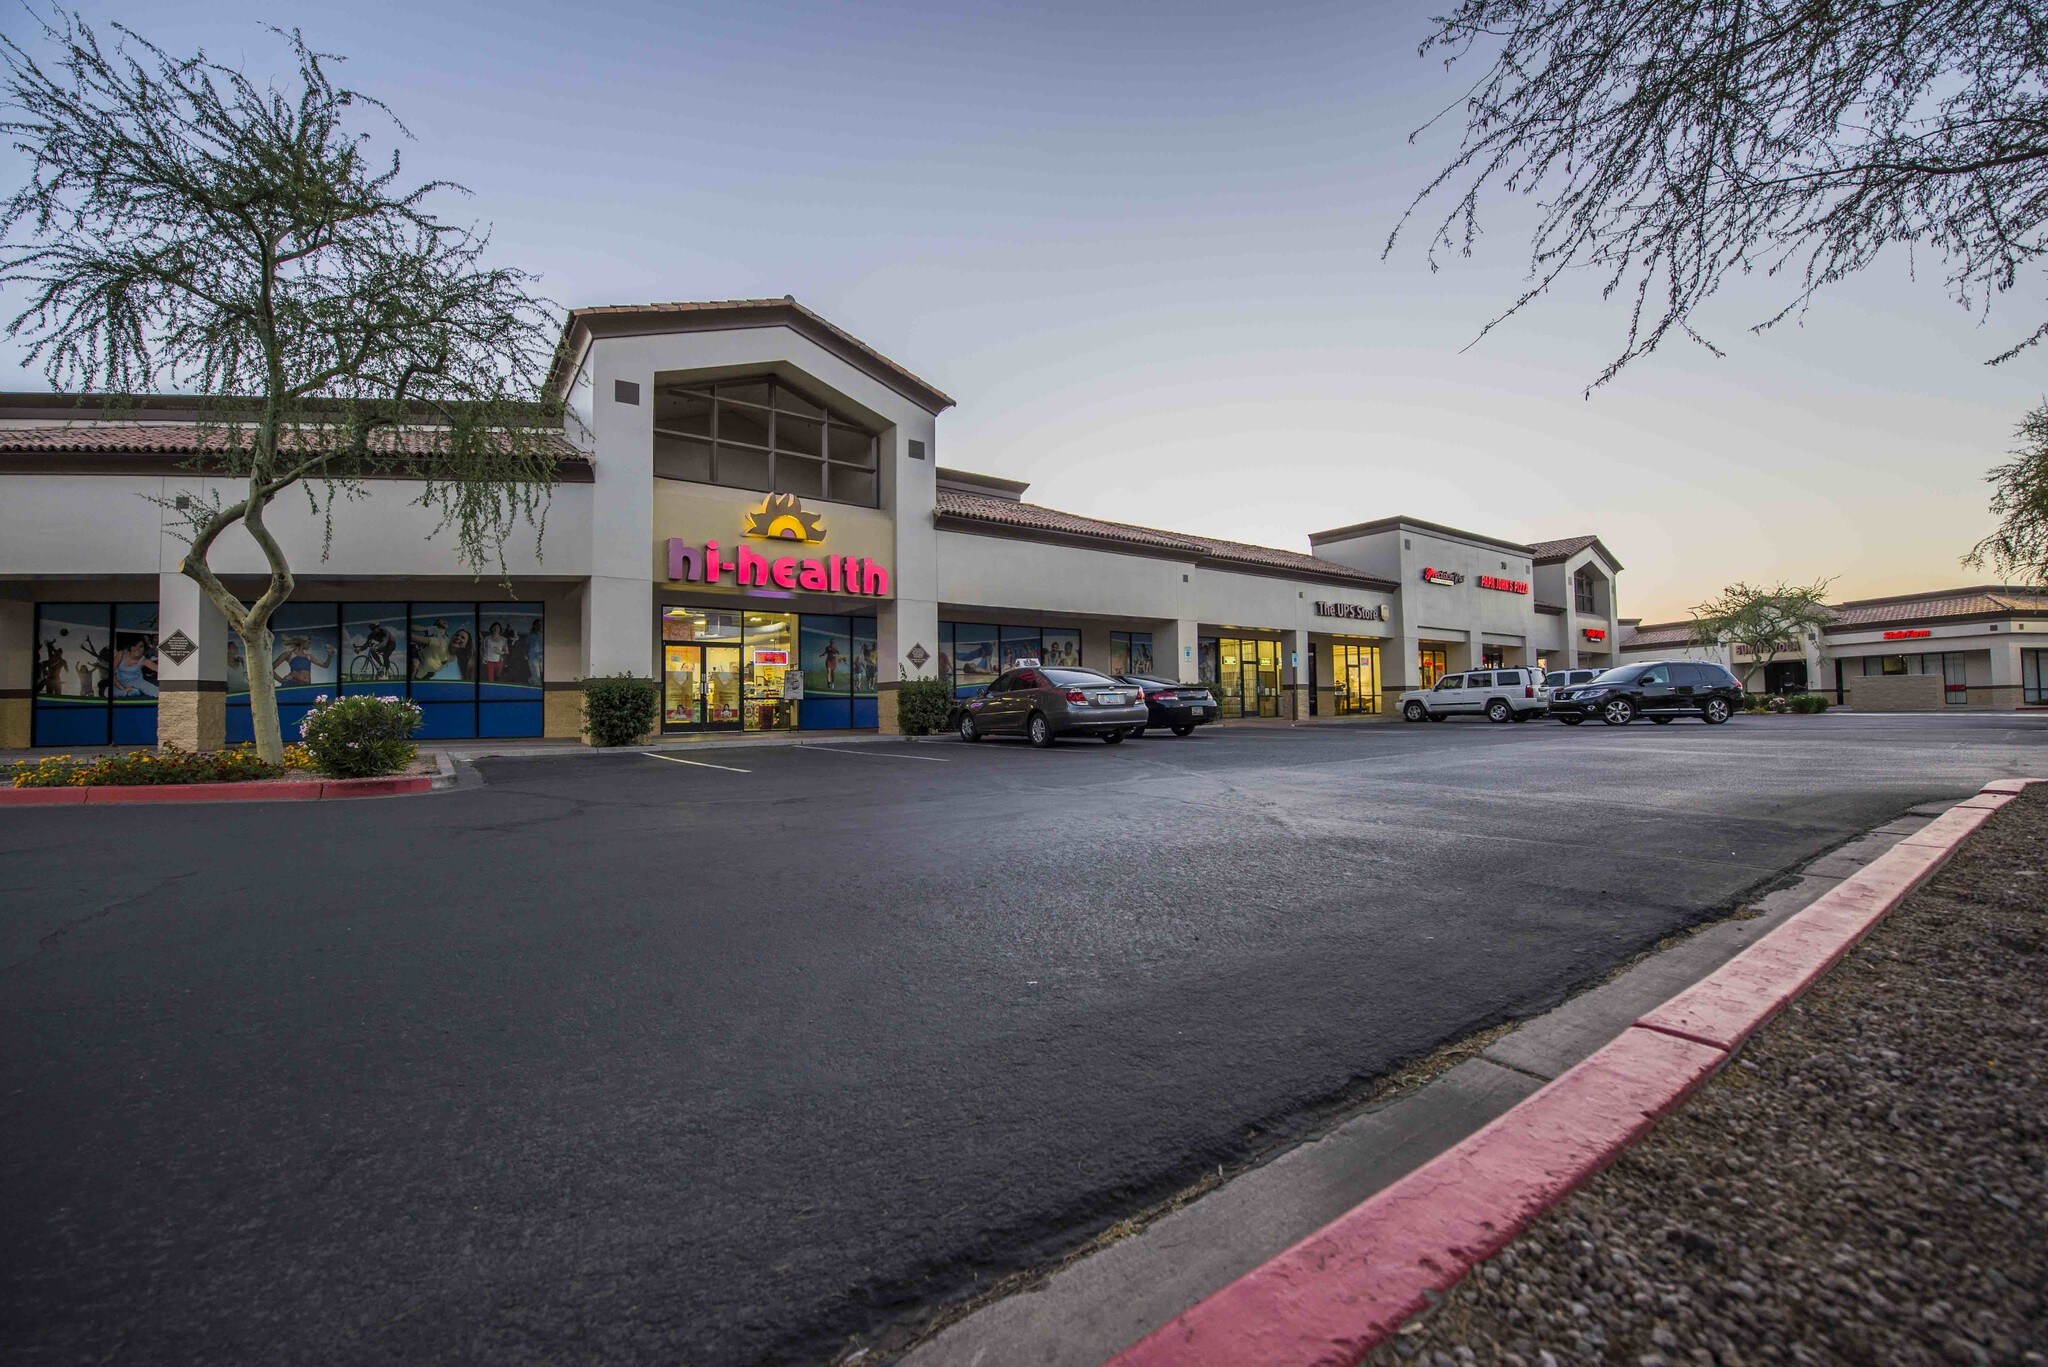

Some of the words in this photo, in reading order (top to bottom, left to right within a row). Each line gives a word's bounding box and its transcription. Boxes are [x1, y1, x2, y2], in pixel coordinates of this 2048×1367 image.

[668, 538, 889, 595] hi-health
[1481, 576, 1495, 589] PAPA
[1514, 581, 1529, 594] PIZZA
[1318, 601, 1335, 616] The
[1337, 603, 1354, 618] UPS
[1356, 605, 1378, 620] Store
